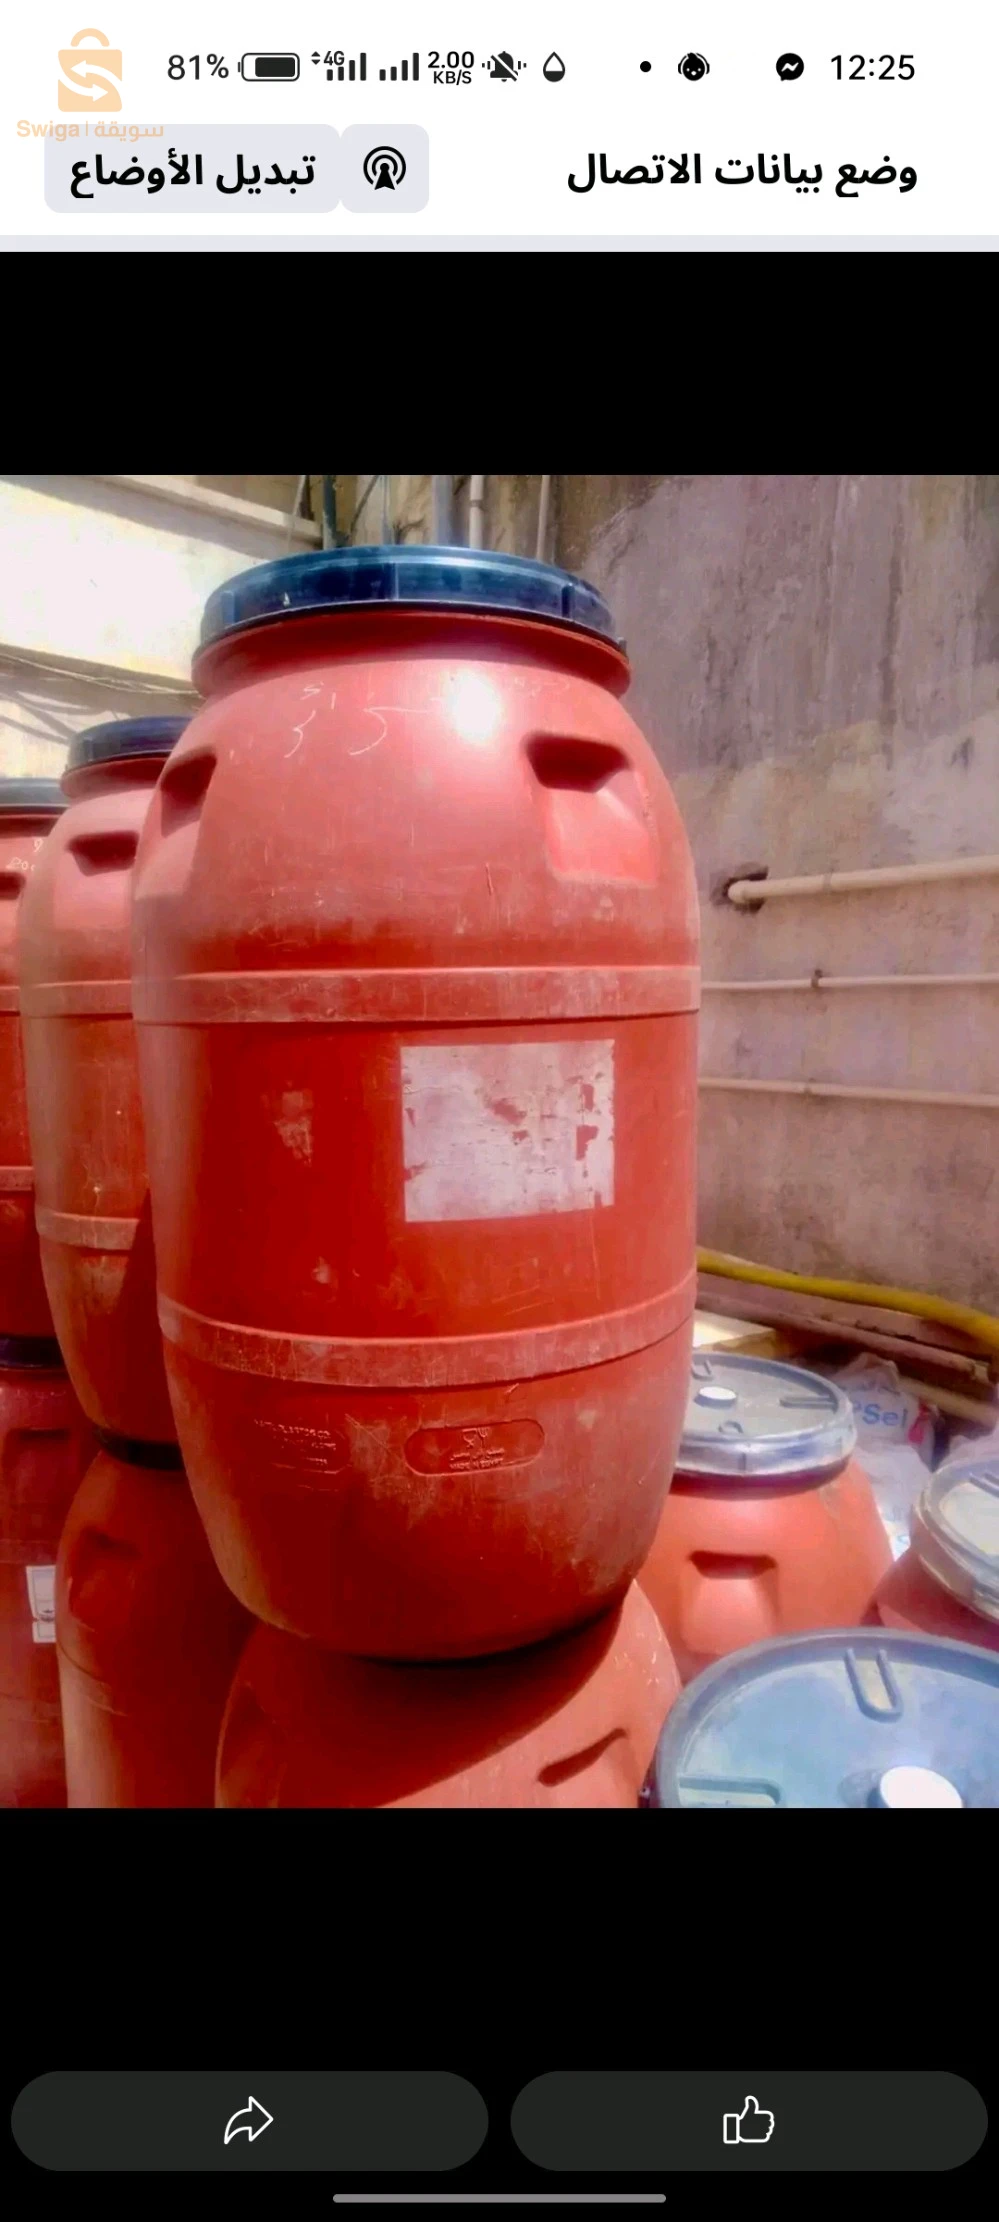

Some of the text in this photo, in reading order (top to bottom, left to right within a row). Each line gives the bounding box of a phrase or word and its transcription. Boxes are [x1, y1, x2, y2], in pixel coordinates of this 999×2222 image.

[167, 53, 229, 81] 81%
[323, 51, 345, 66] 4G
[427, 51, 475, 69] 2.00
[830, 54, 916, 81] 12:25
[433, 70, 472, 85] KB/S
[70, 147, 316, 199] تبديل الأوضاع
[567, 153, 918, 198] وضع بيانات الاتصال
